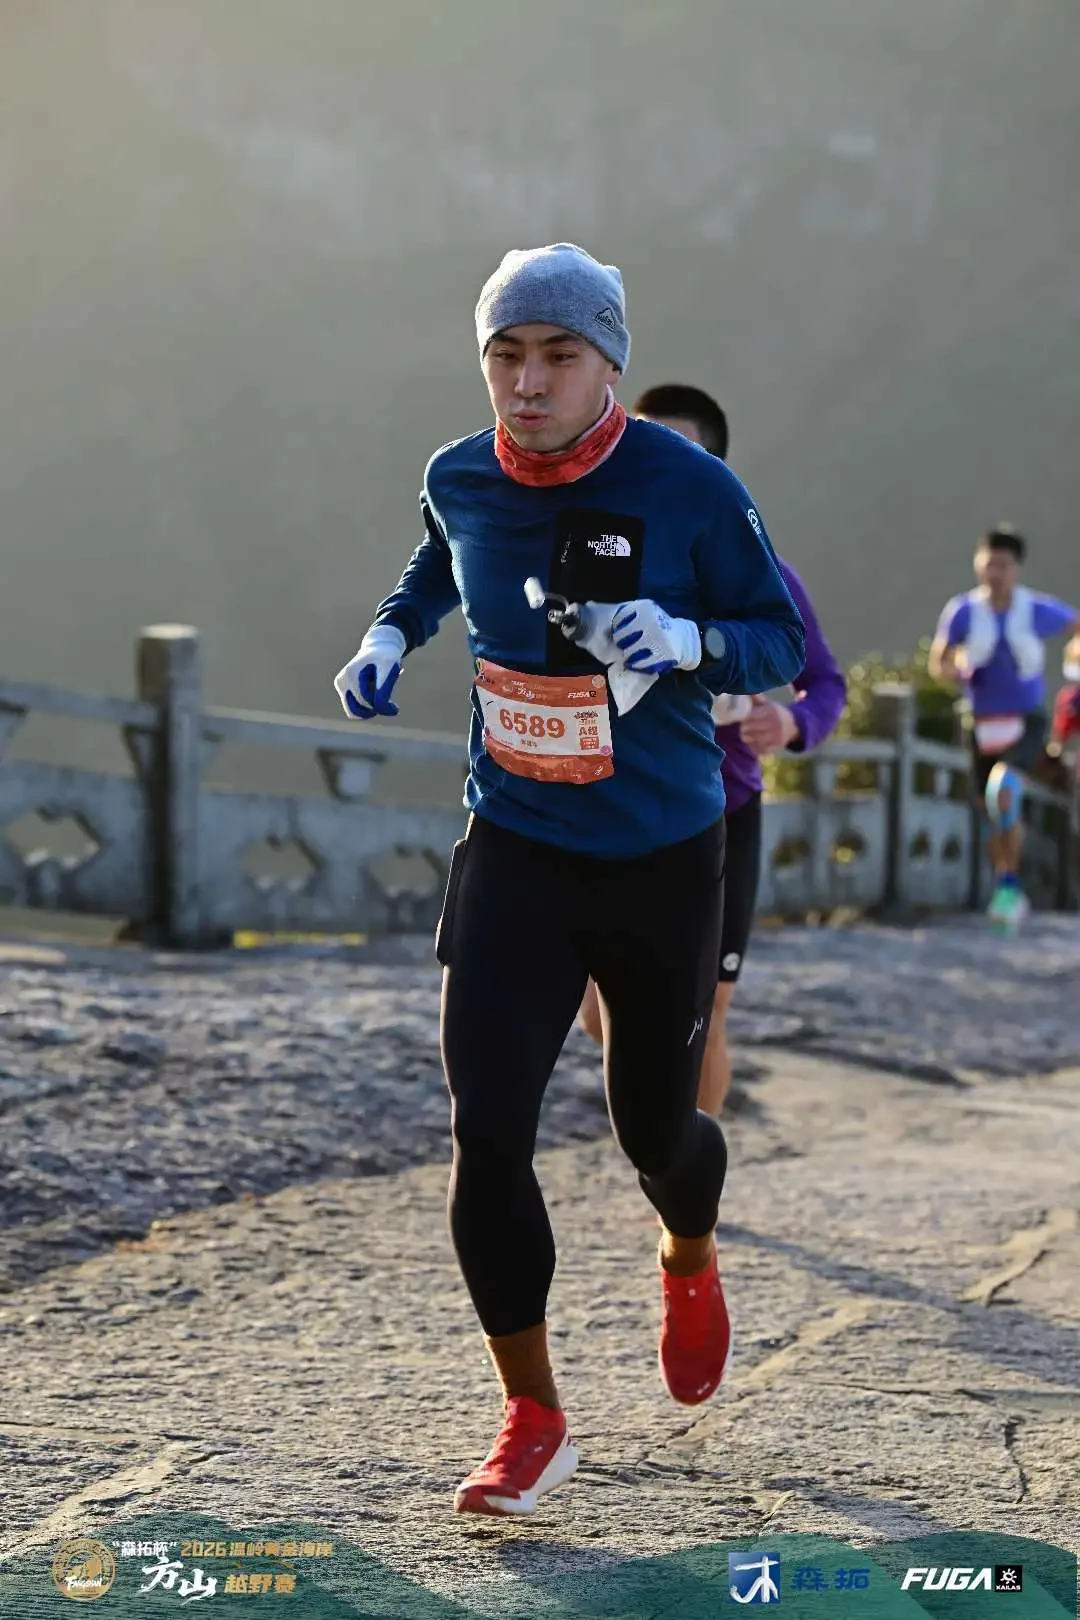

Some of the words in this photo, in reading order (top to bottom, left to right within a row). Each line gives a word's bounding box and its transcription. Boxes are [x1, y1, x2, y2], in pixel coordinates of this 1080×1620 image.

[601, 534, 617, 543] THE
[587, 540, 616, 549] NORTH
[594, 548, 616, 557] FACE
[499, 708, 566, 739] 6589
